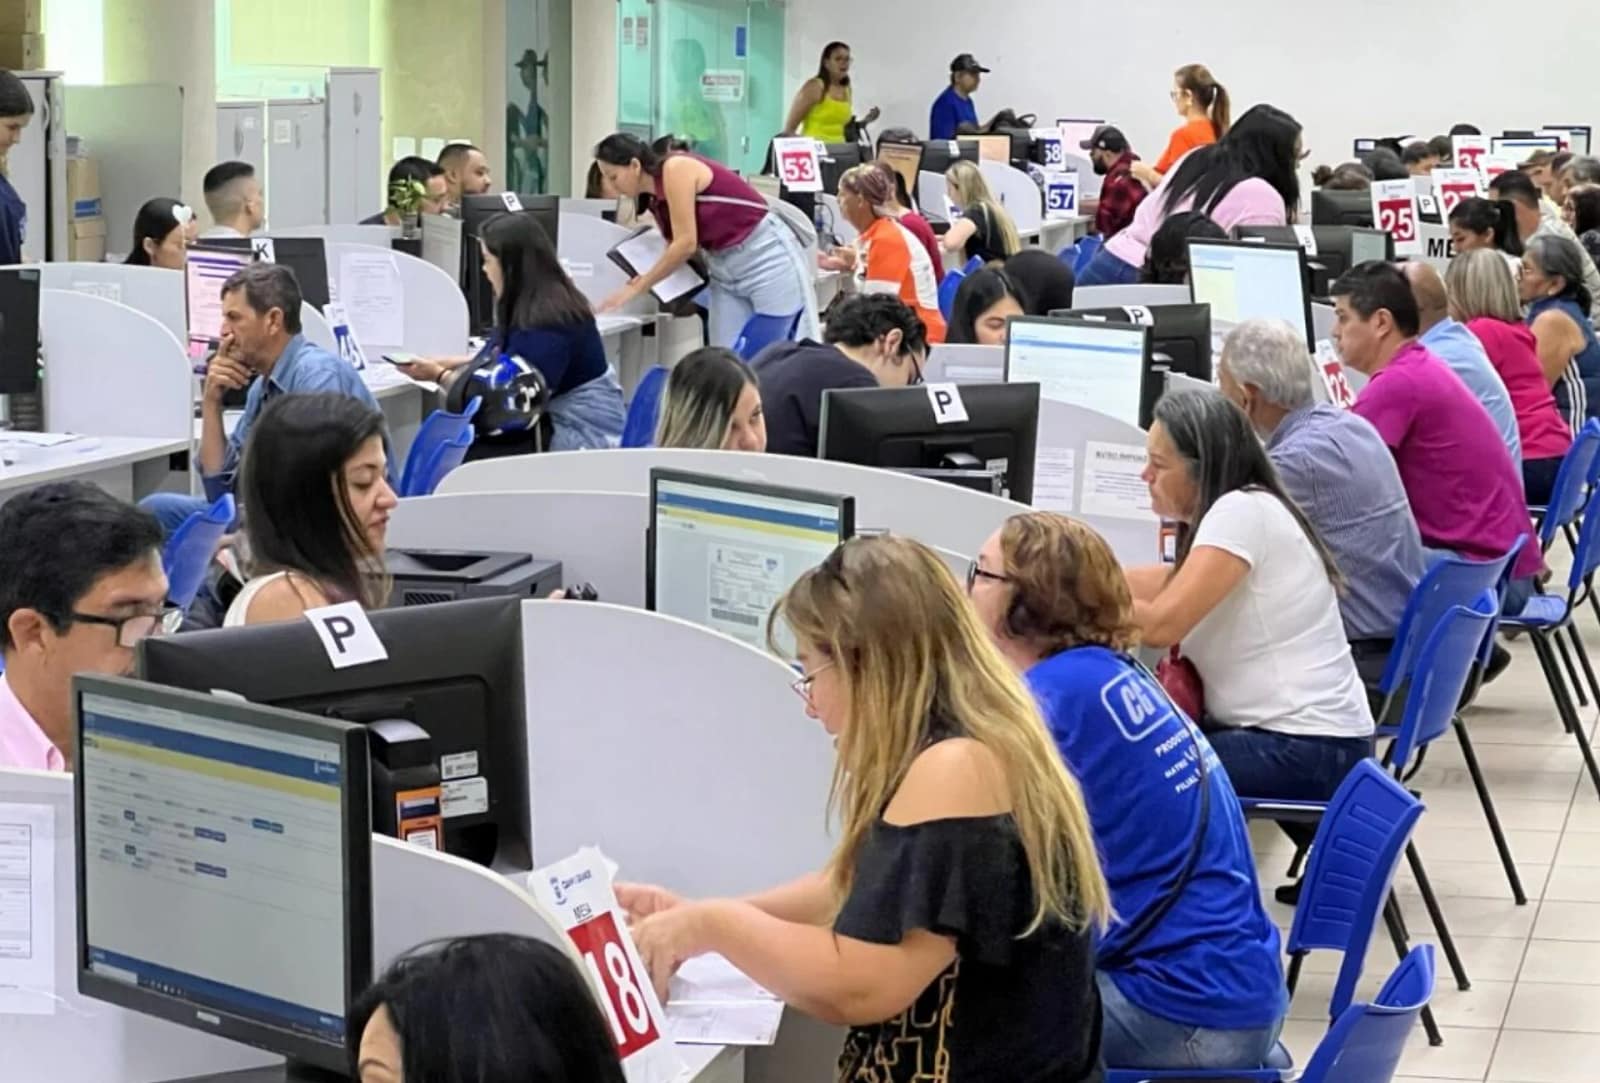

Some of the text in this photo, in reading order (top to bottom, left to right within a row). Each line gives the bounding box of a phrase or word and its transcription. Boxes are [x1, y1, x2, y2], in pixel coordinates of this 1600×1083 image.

[784, 157, 815, 180] 53
[1049, 189, 1073, 209] 57
[1422, 199, 1432, 210] P
[1381, 207, 1414, 239] 25
[256, 243, 269, 258] K
[1131, 309, 1144, 323] P
[1329, 371, 1355, 407] 23
[934, 390, 952, 415] P
[322, 615, 356, 653] P
[583, 941, 651, 1045] 18
